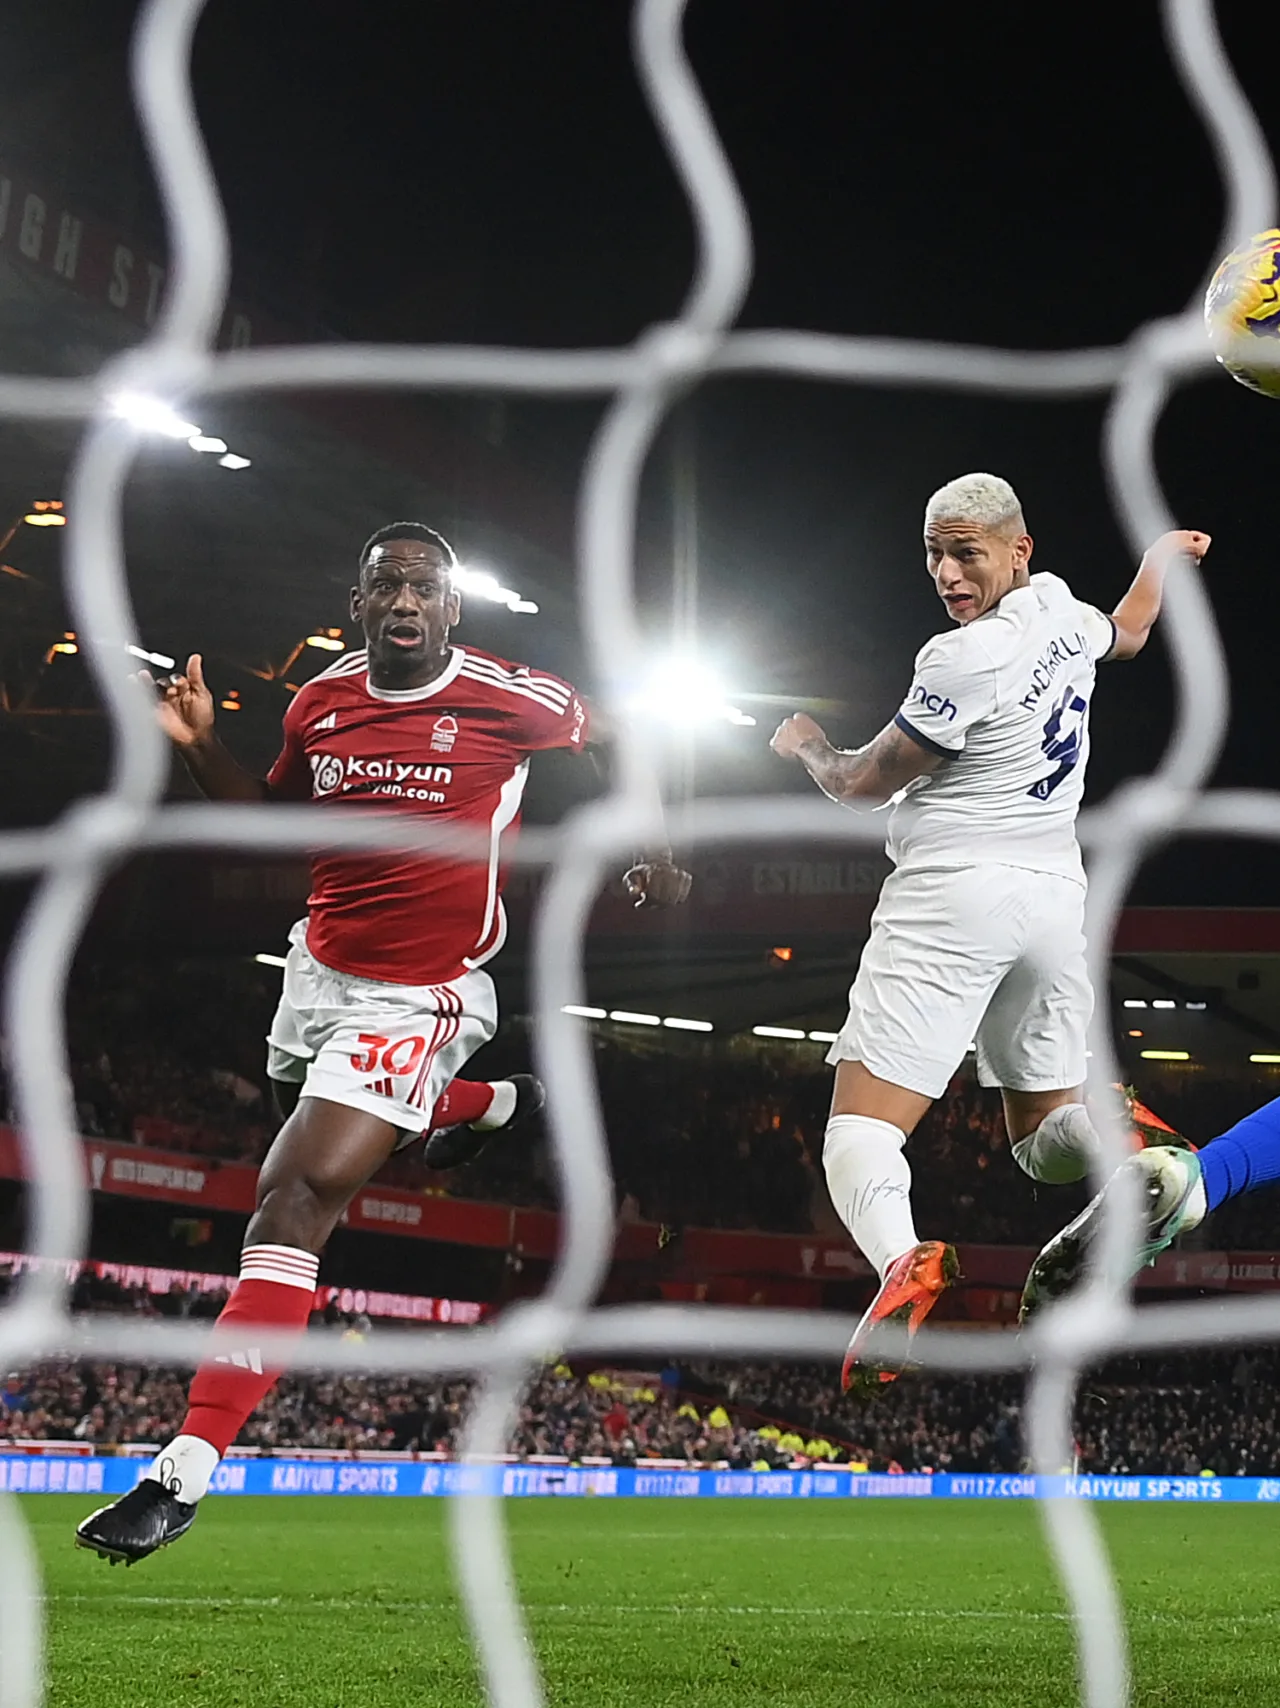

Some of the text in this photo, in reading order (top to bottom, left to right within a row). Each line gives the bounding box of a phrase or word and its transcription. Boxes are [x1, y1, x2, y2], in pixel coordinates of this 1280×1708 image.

[346, 755, 452, 784] kaiyun
[350, 1033, 425, 1075] 30
[271, 1464, 397, 1492] KAIYUN SPORTS
[951, 1477, 1036, 1496] KY117.COM
[1065, 1480, 1222, 1498] KAIYUN SPORTS
